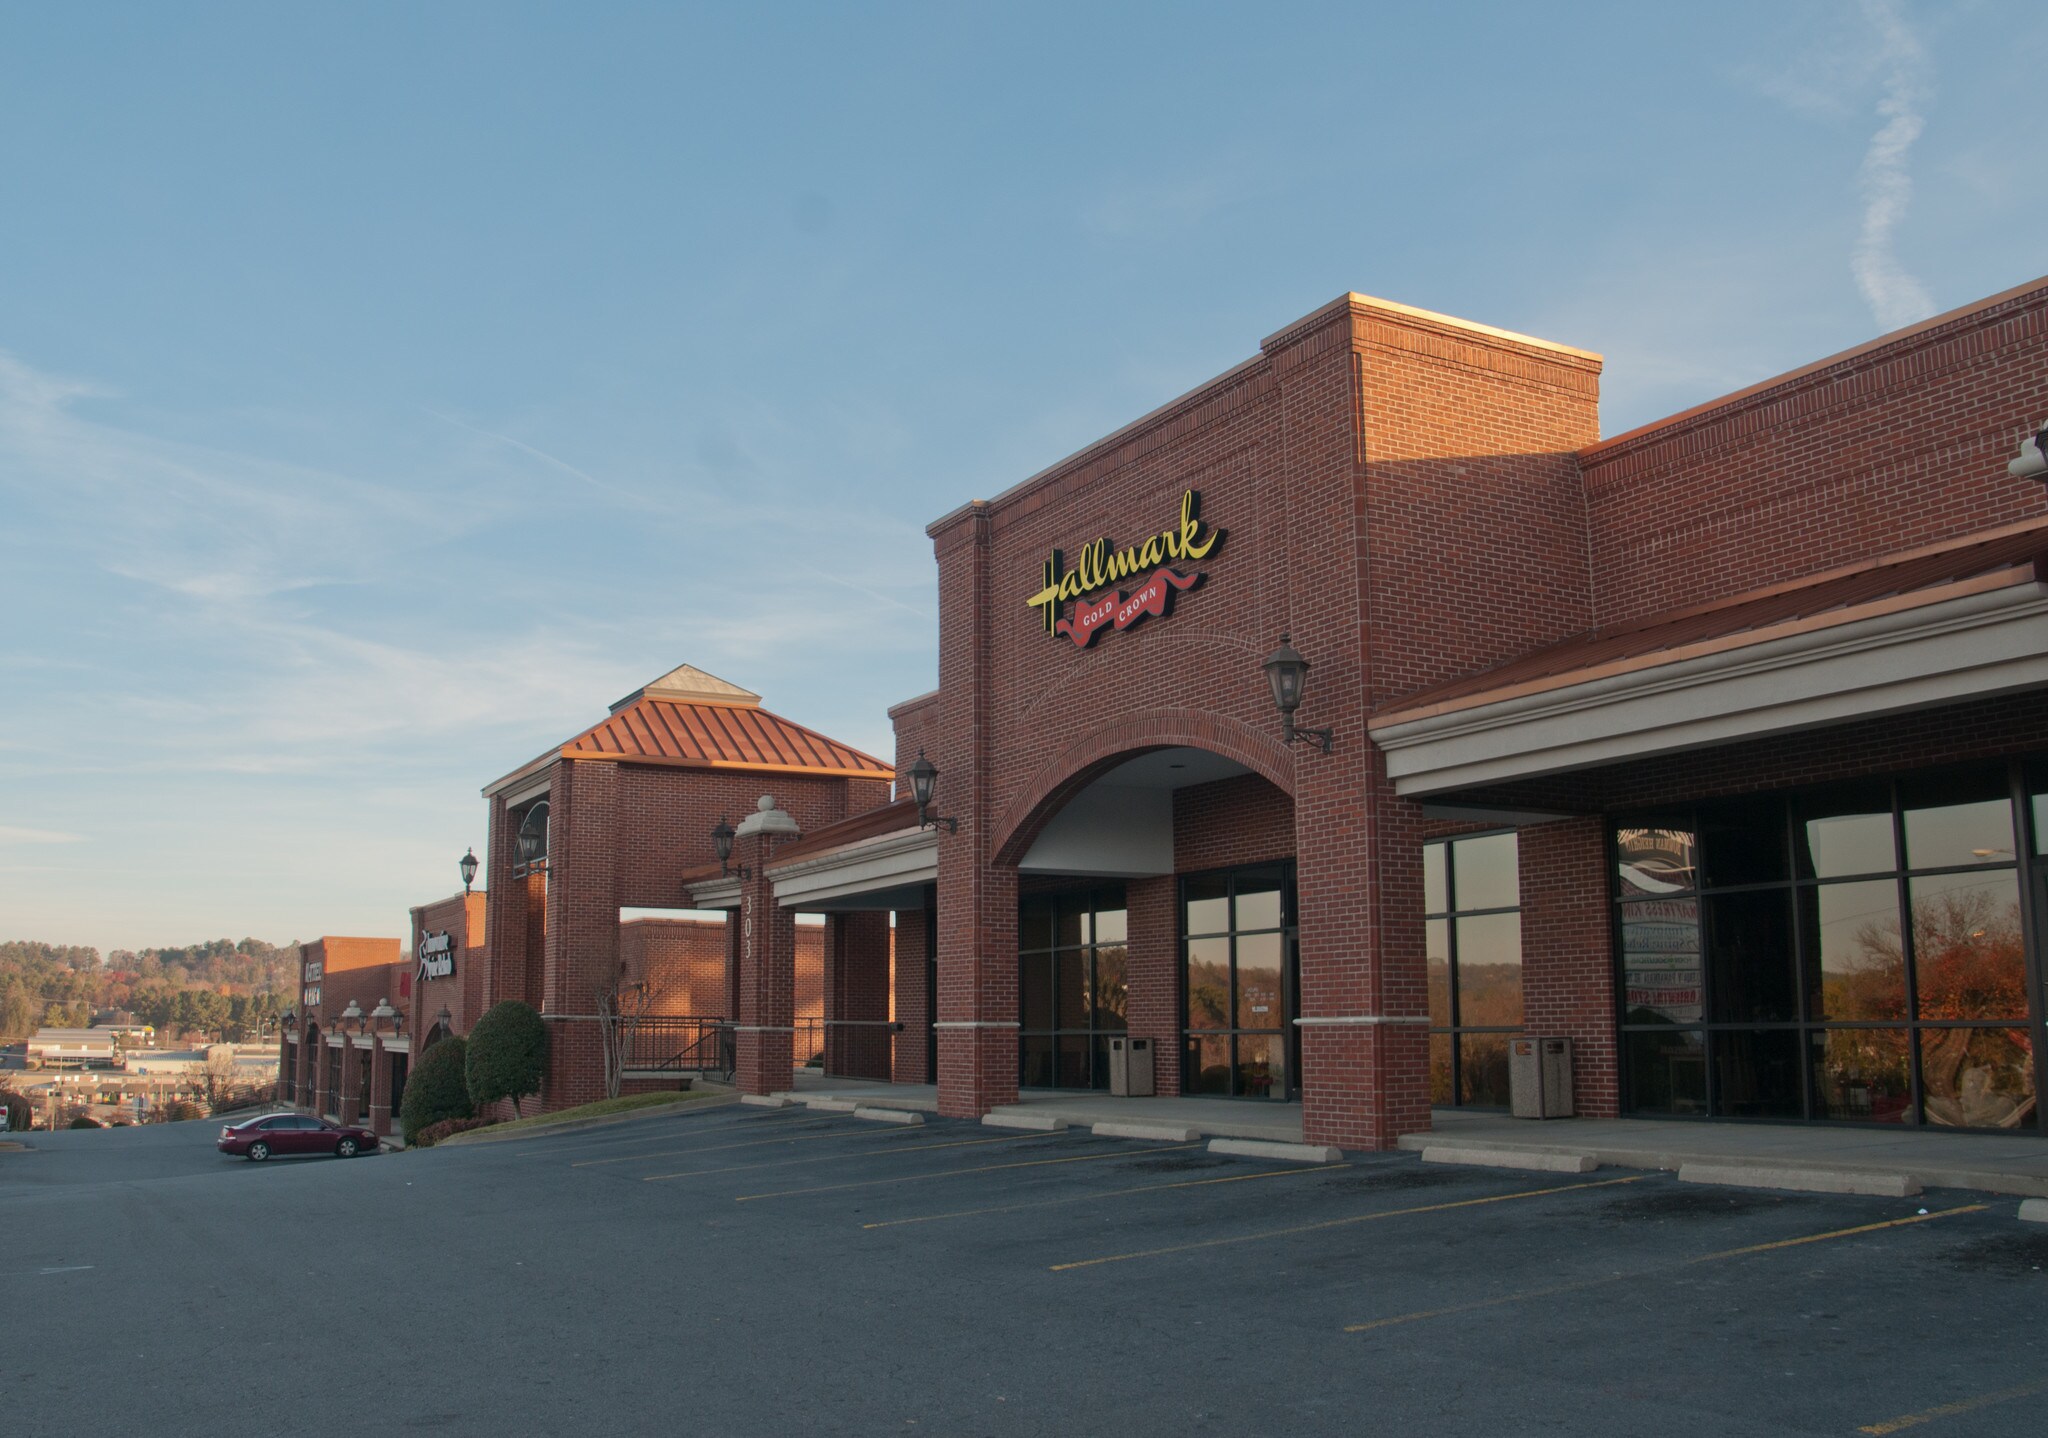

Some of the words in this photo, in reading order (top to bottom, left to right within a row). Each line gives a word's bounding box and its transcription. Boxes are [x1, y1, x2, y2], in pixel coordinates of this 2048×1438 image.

[1026, 489, 1219, 637] Hallmark
[1083, 601, 1112, 626] GOLD
[1118, 586, 1157, 622] CROWN
